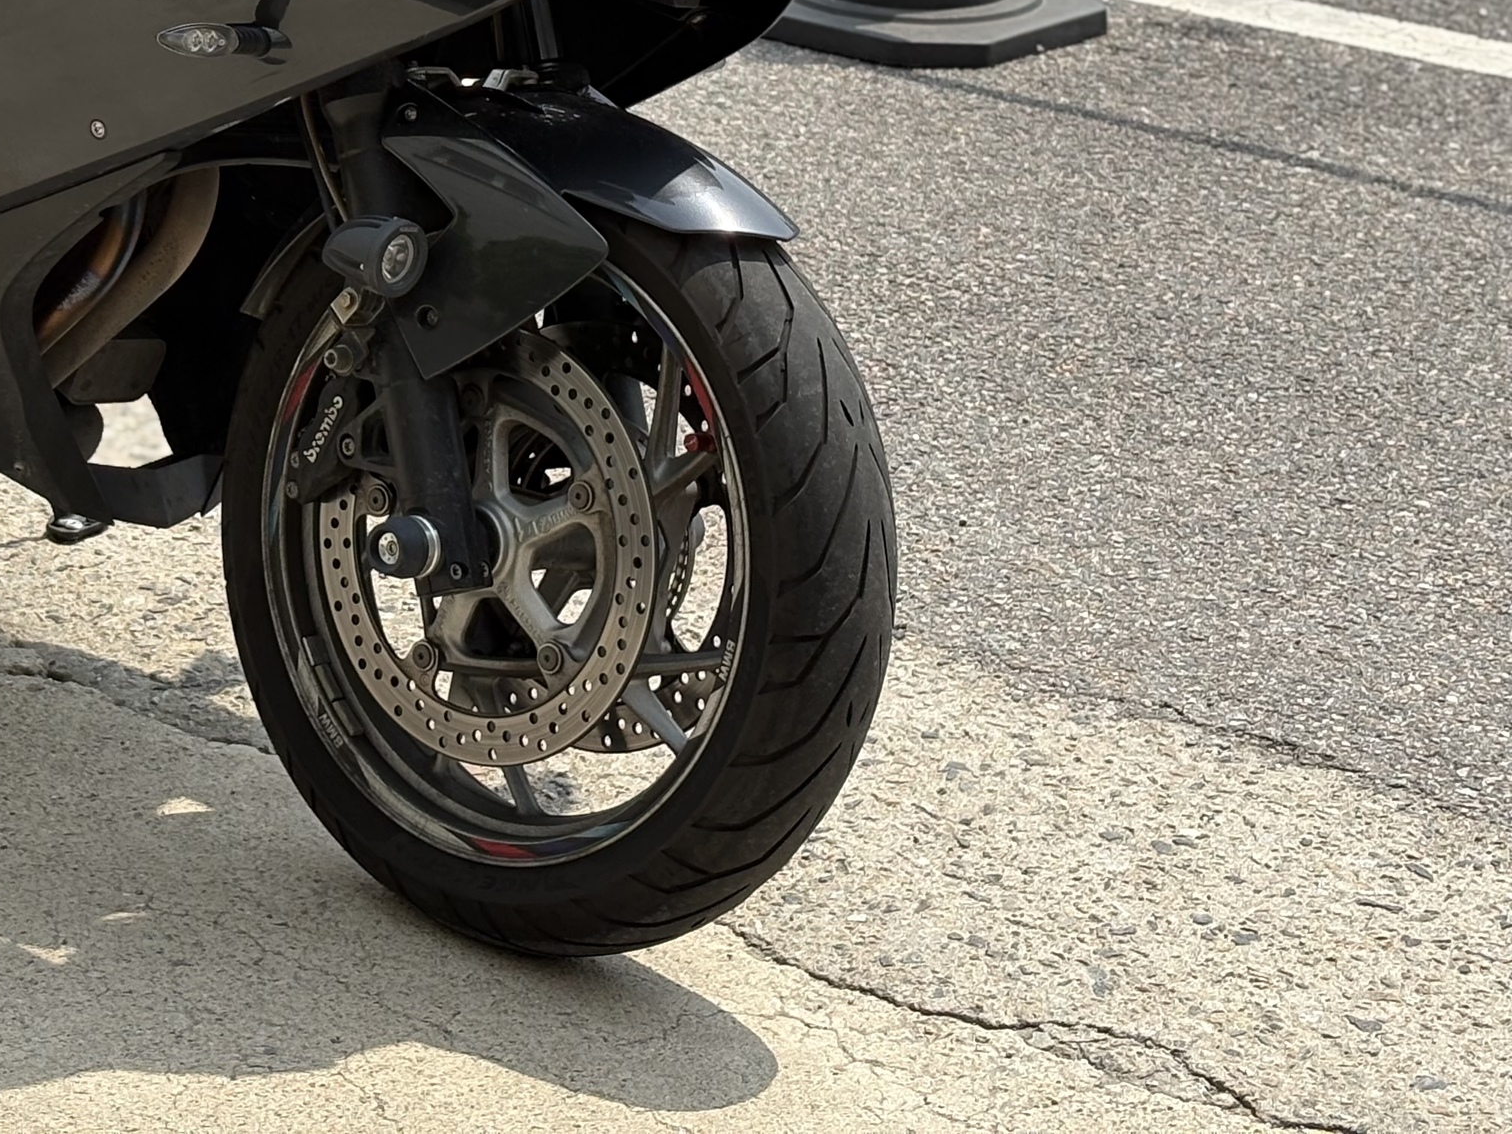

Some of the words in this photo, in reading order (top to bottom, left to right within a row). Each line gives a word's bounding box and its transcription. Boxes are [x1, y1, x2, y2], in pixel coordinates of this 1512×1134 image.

[303, 395, 344, 464] brembo
[718, 638, 736, 683] BMW
[318, 712, 344, 749] BMW
